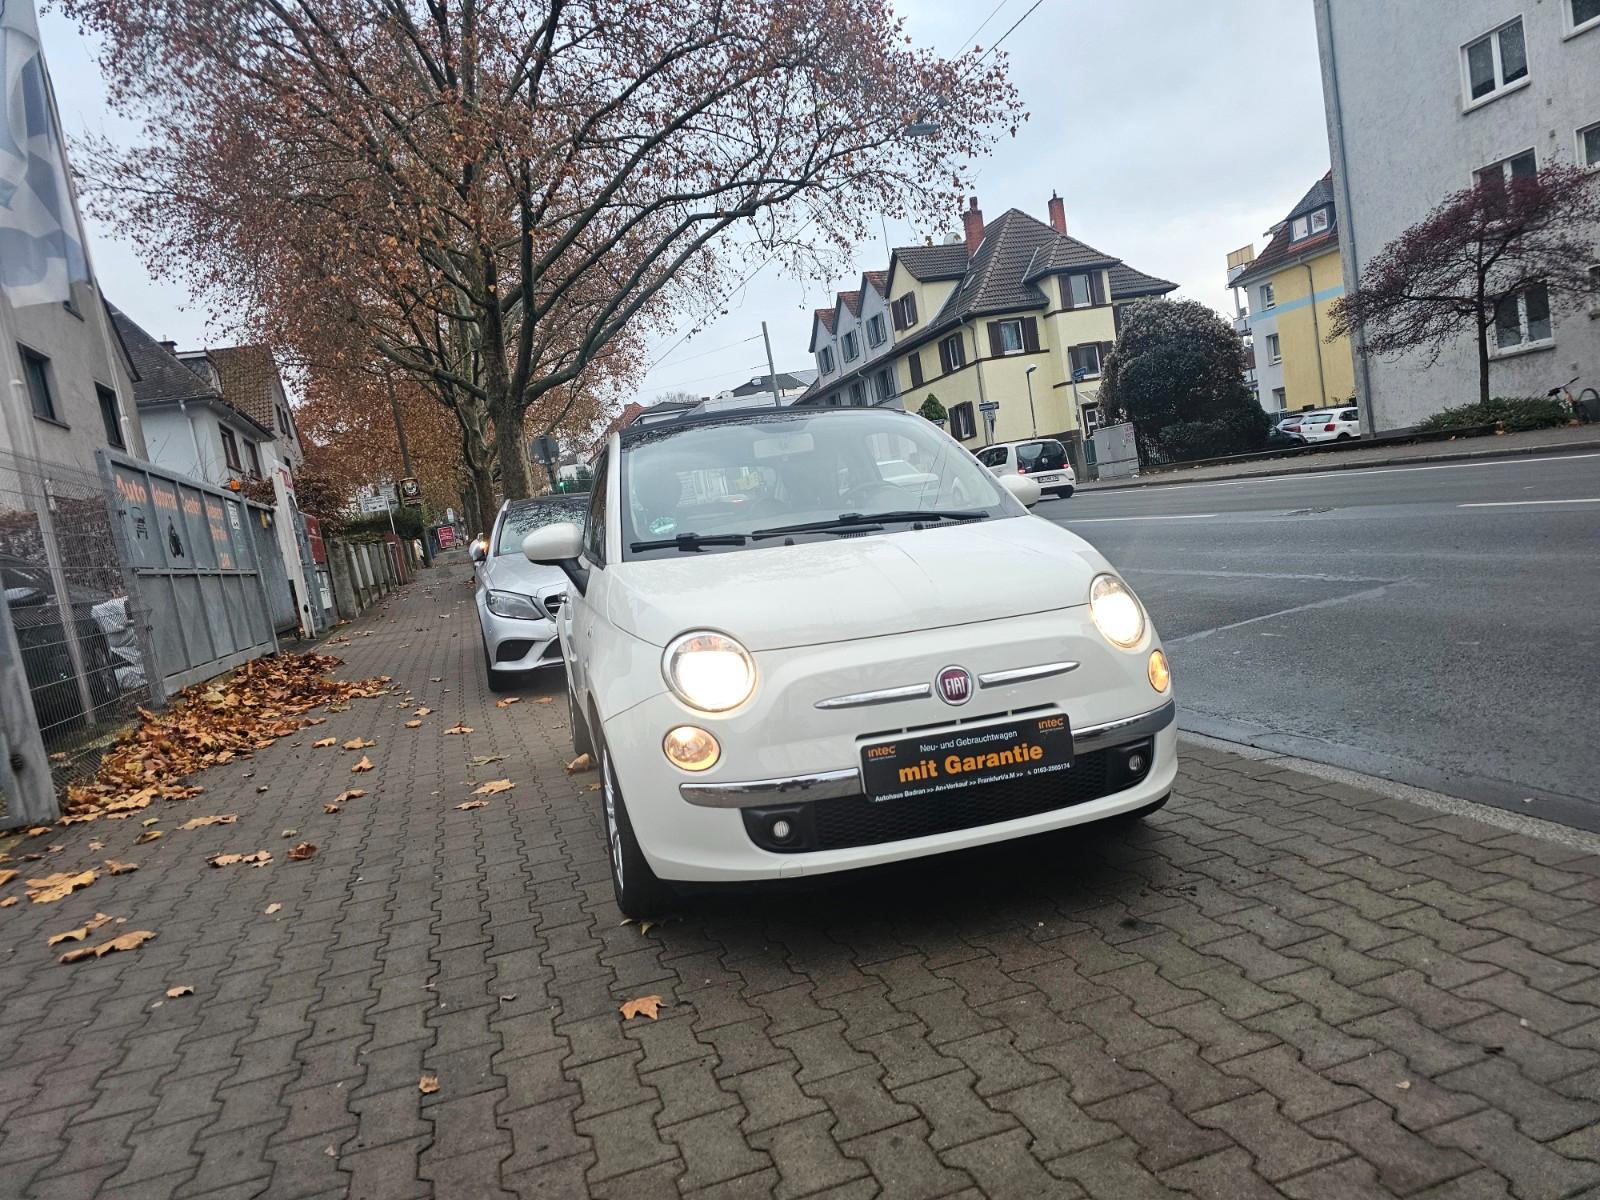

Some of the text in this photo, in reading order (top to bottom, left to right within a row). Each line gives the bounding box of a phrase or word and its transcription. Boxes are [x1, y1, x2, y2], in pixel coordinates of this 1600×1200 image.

[944, 676, 966, 696] FIAT
[919, 730, 1018, 753] Neu- und Gebrauchtwagen
[898, 742, 1044, 783] mit Garantie
[875, 793, 904, 802] Autohaus
